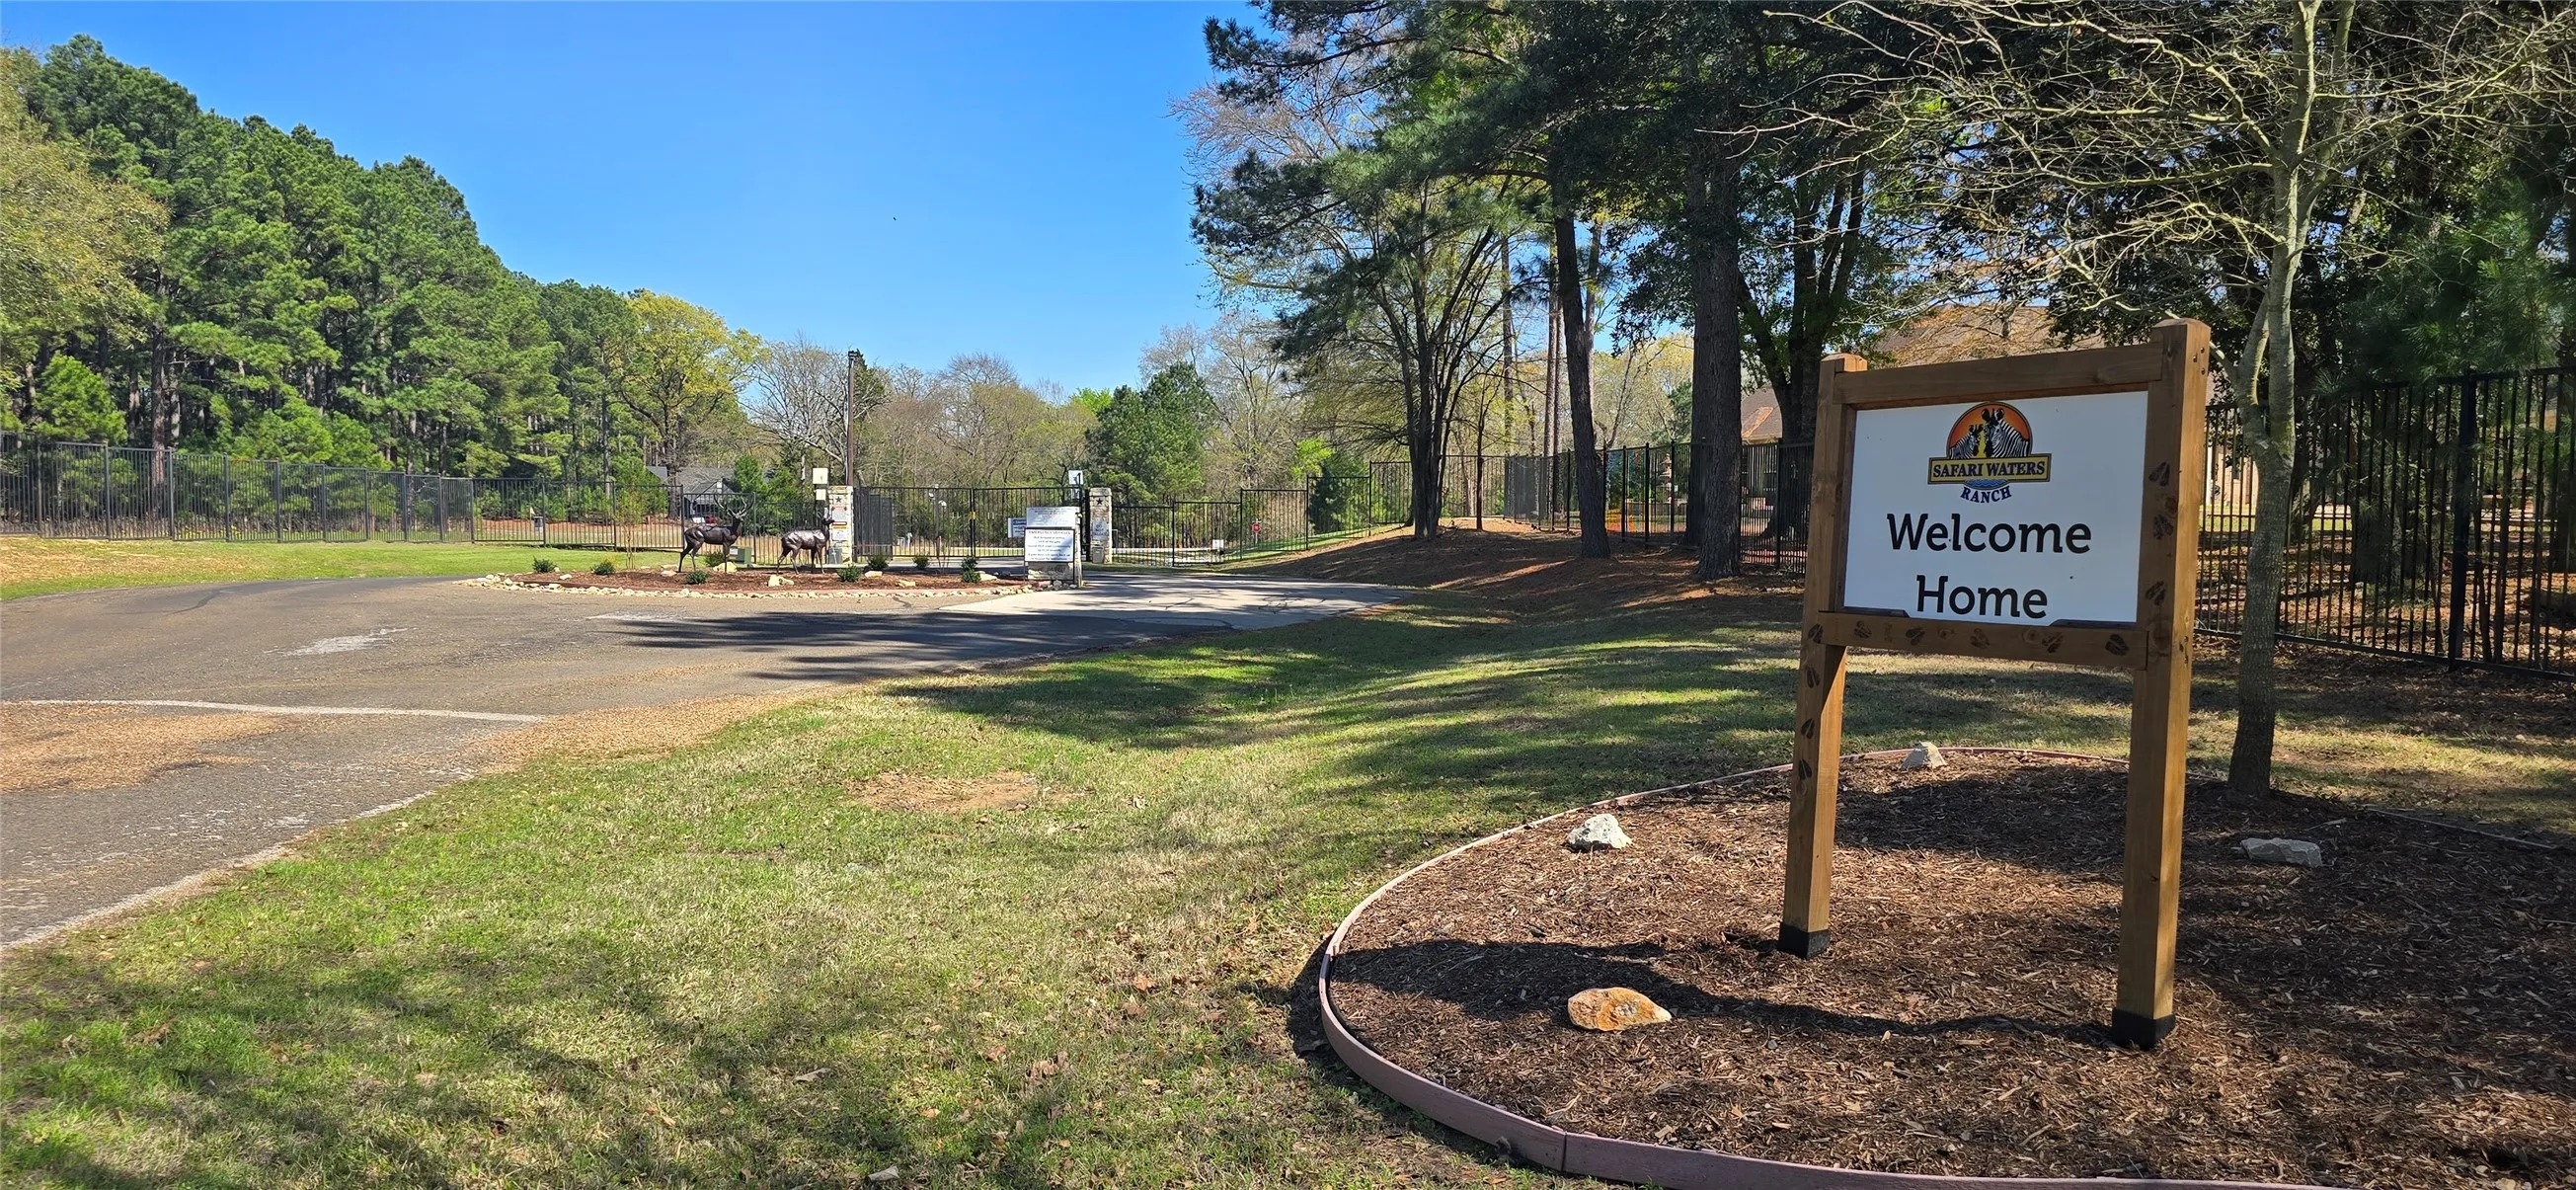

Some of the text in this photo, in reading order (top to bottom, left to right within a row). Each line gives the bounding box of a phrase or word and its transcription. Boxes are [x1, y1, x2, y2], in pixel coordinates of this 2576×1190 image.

[1932, 460, 2045, 478] SAFARI WATERS
[1961, 486, 2011, 504] RANCH
[1887, 513, 2092, 554] Welcome
[1916, 575, 2049, 619] Home
